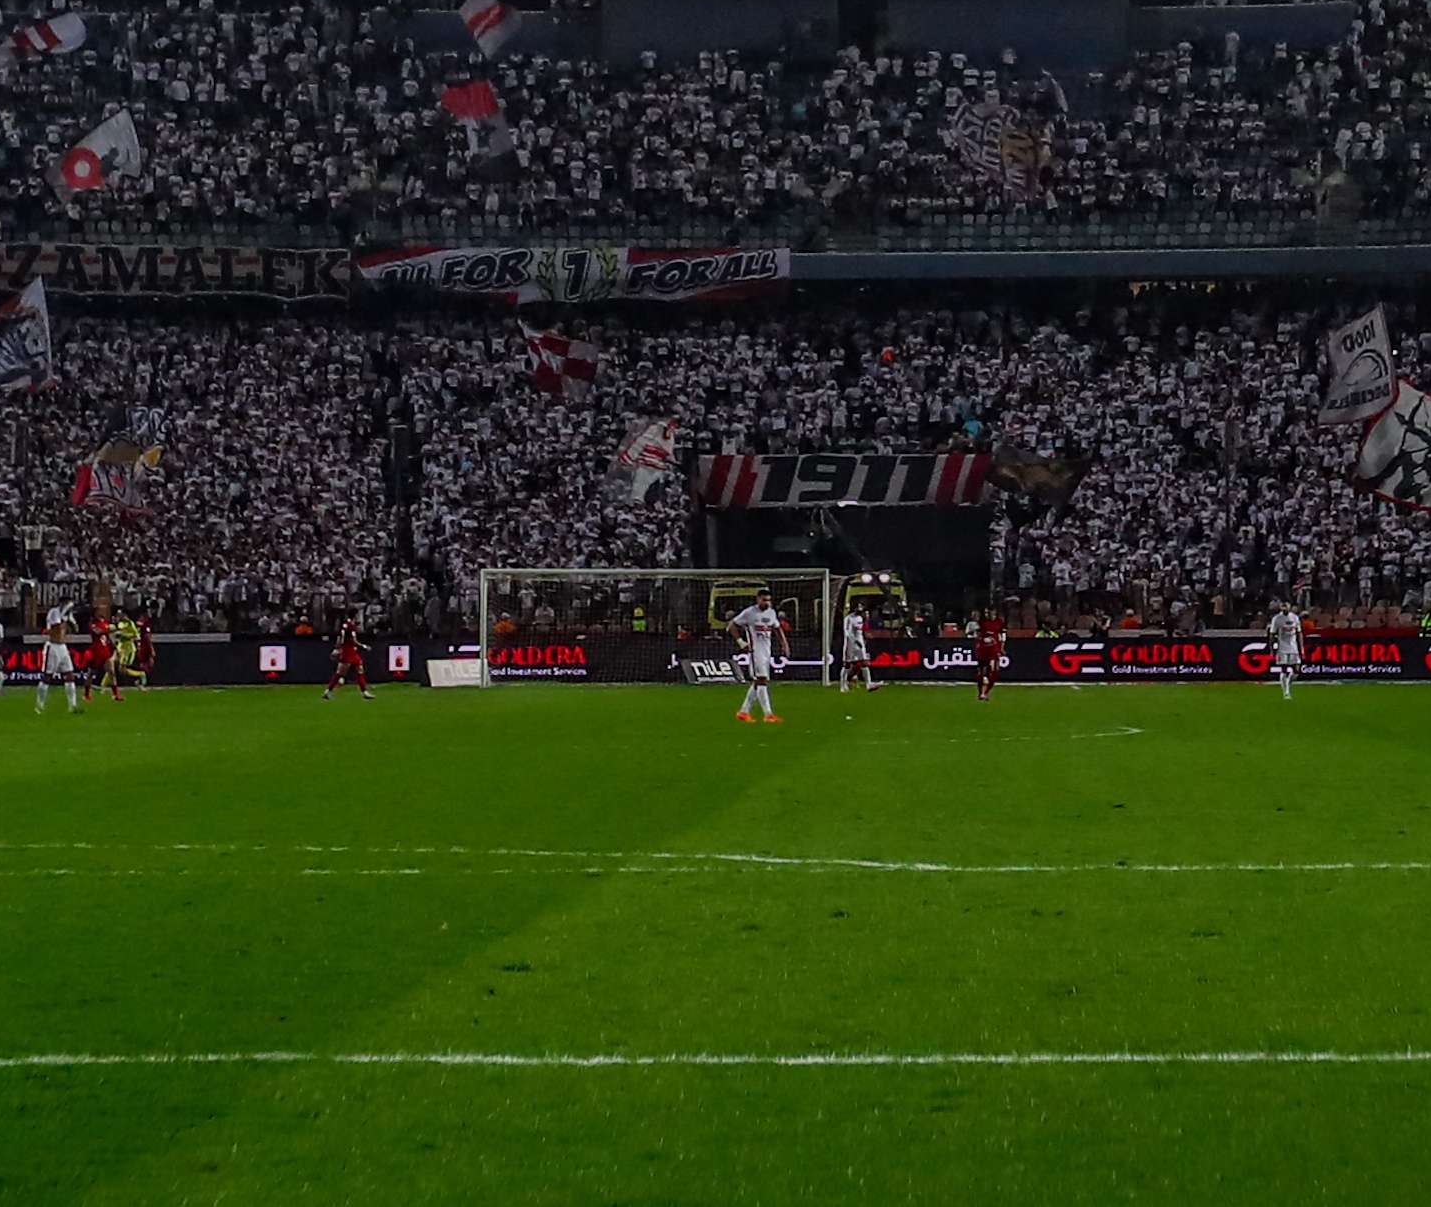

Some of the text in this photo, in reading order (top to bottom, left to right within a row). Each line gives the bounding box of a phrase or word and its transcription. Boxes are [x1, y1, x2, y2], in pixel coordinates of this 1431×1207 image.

[3, 244, 345, 300] ZAMALEK
[442, 248, 534, 288] FOR
[561, 248, 591, 300] 1
[628, 257, 718, 294] FOR
[716, 249, 778, 280] ALL
[772, 454, 948, 504] 1911
[1133, 664, 1175, 674] Investment
[1177, 664, 1214, 674] Services
[1368, 664, 1403, 674] Services
